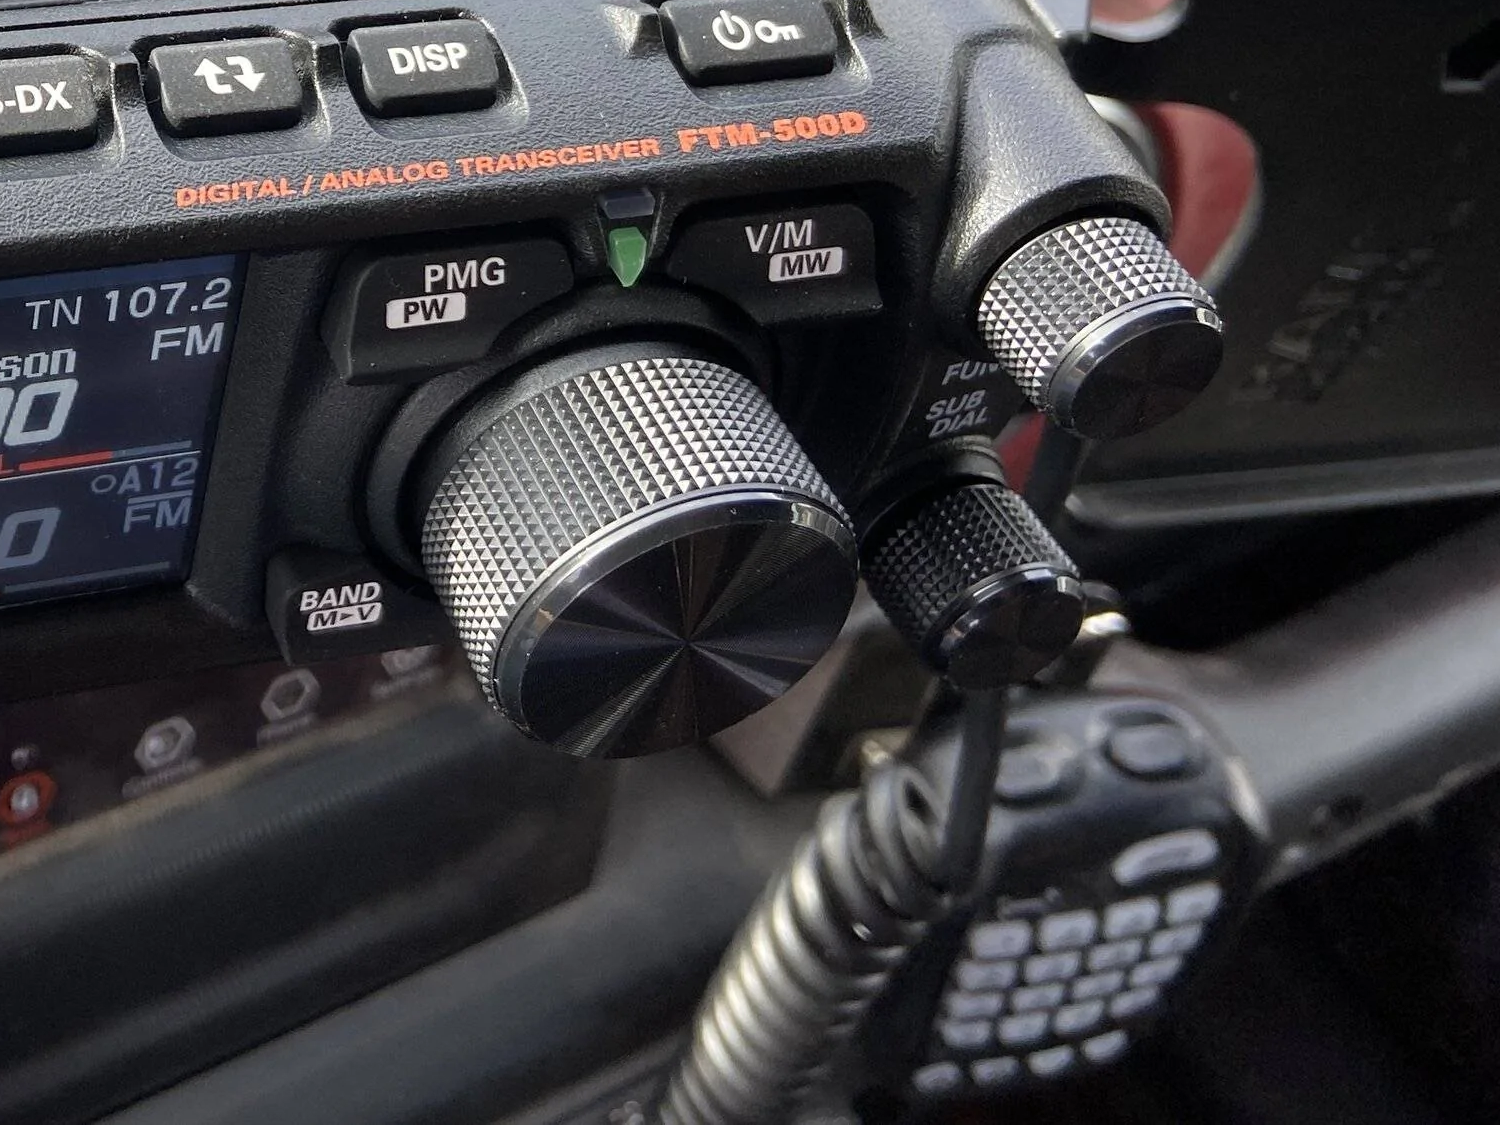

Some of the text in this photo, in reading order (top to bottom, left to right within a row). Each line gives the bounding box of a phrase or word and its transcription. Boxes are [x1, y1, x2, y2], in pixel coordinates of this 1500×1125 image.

[389, 42, 469, 74] DISP
[177, 179, 297, 207] DIGITAL
[321, 160, 449, 191] ANALOG
[461, 139, 661, 176] TRANSCEIVER
[677, 111, 869, 154] FTM-500D
[745, 219, 814, 252] V/M
[425, 260, 506, 293] PMG
[781, 252, 834, 278] MW
[25, 277, 232, 330] TN 107.2
[402, 299, 448, 324] PW
[151, 322, 225, 361] FM
[926, 390, 986, 420] SUB
[928, 407, 988, 438] DIAL
[123, 497, 192, 533] FM
[300, 582, 381, 611] BAND
